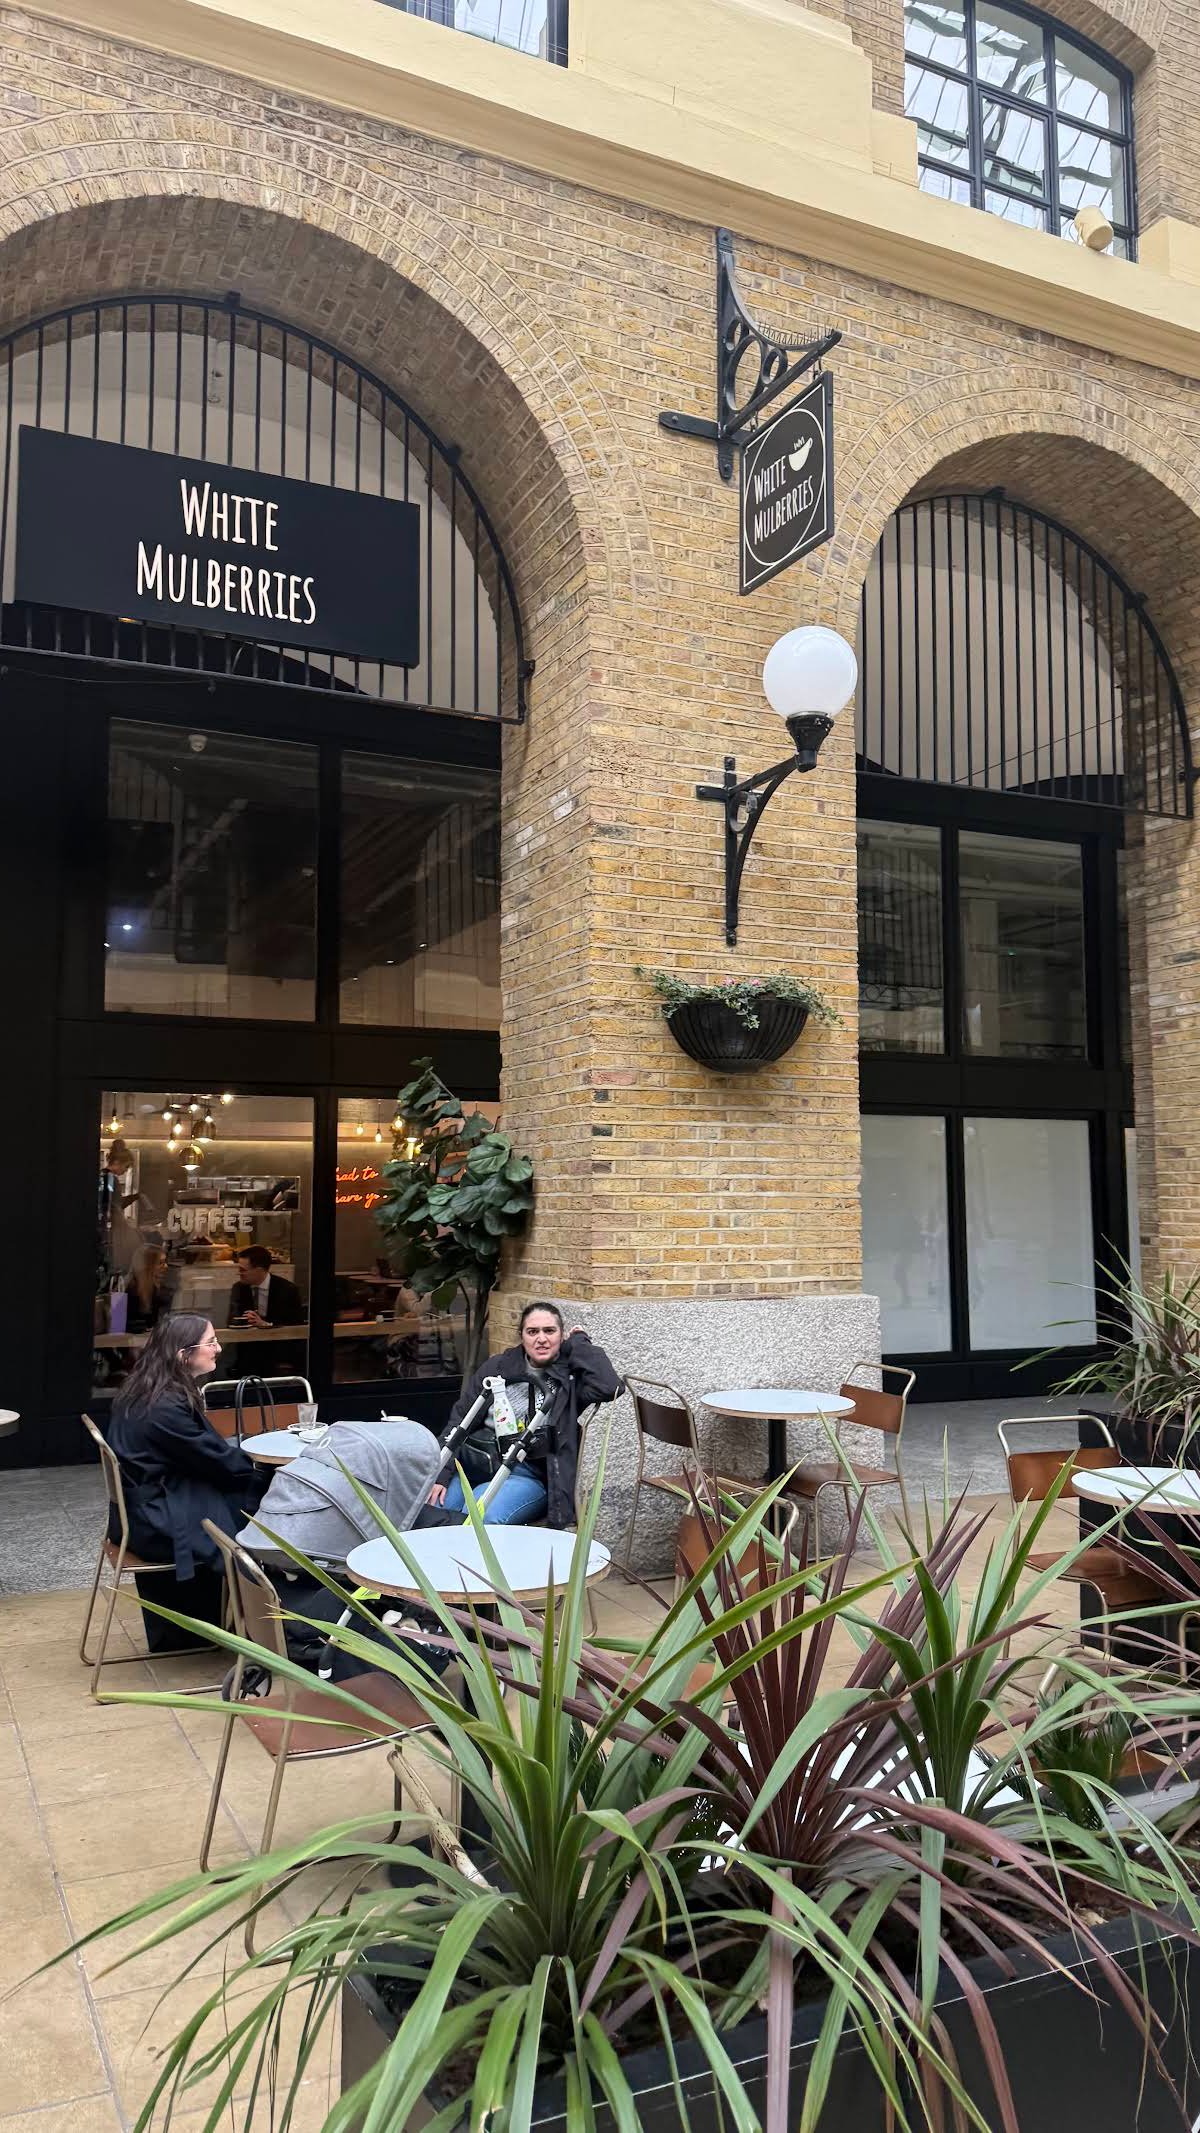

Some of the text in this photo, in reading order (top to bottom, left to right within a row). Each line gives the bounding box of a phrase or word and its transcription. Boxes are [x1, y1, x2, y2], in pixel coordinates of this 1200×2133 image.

[754, 456, 787, 504] WHITE
[180, 479, 279, 551] WHITE
[754, 475, 814, 545] MULBERRIES
[137, 541, 316, 625] MULBERRIES
[362, 1166, 379, 1180] to
[167, 1207, 253, 1233] COFFEE
